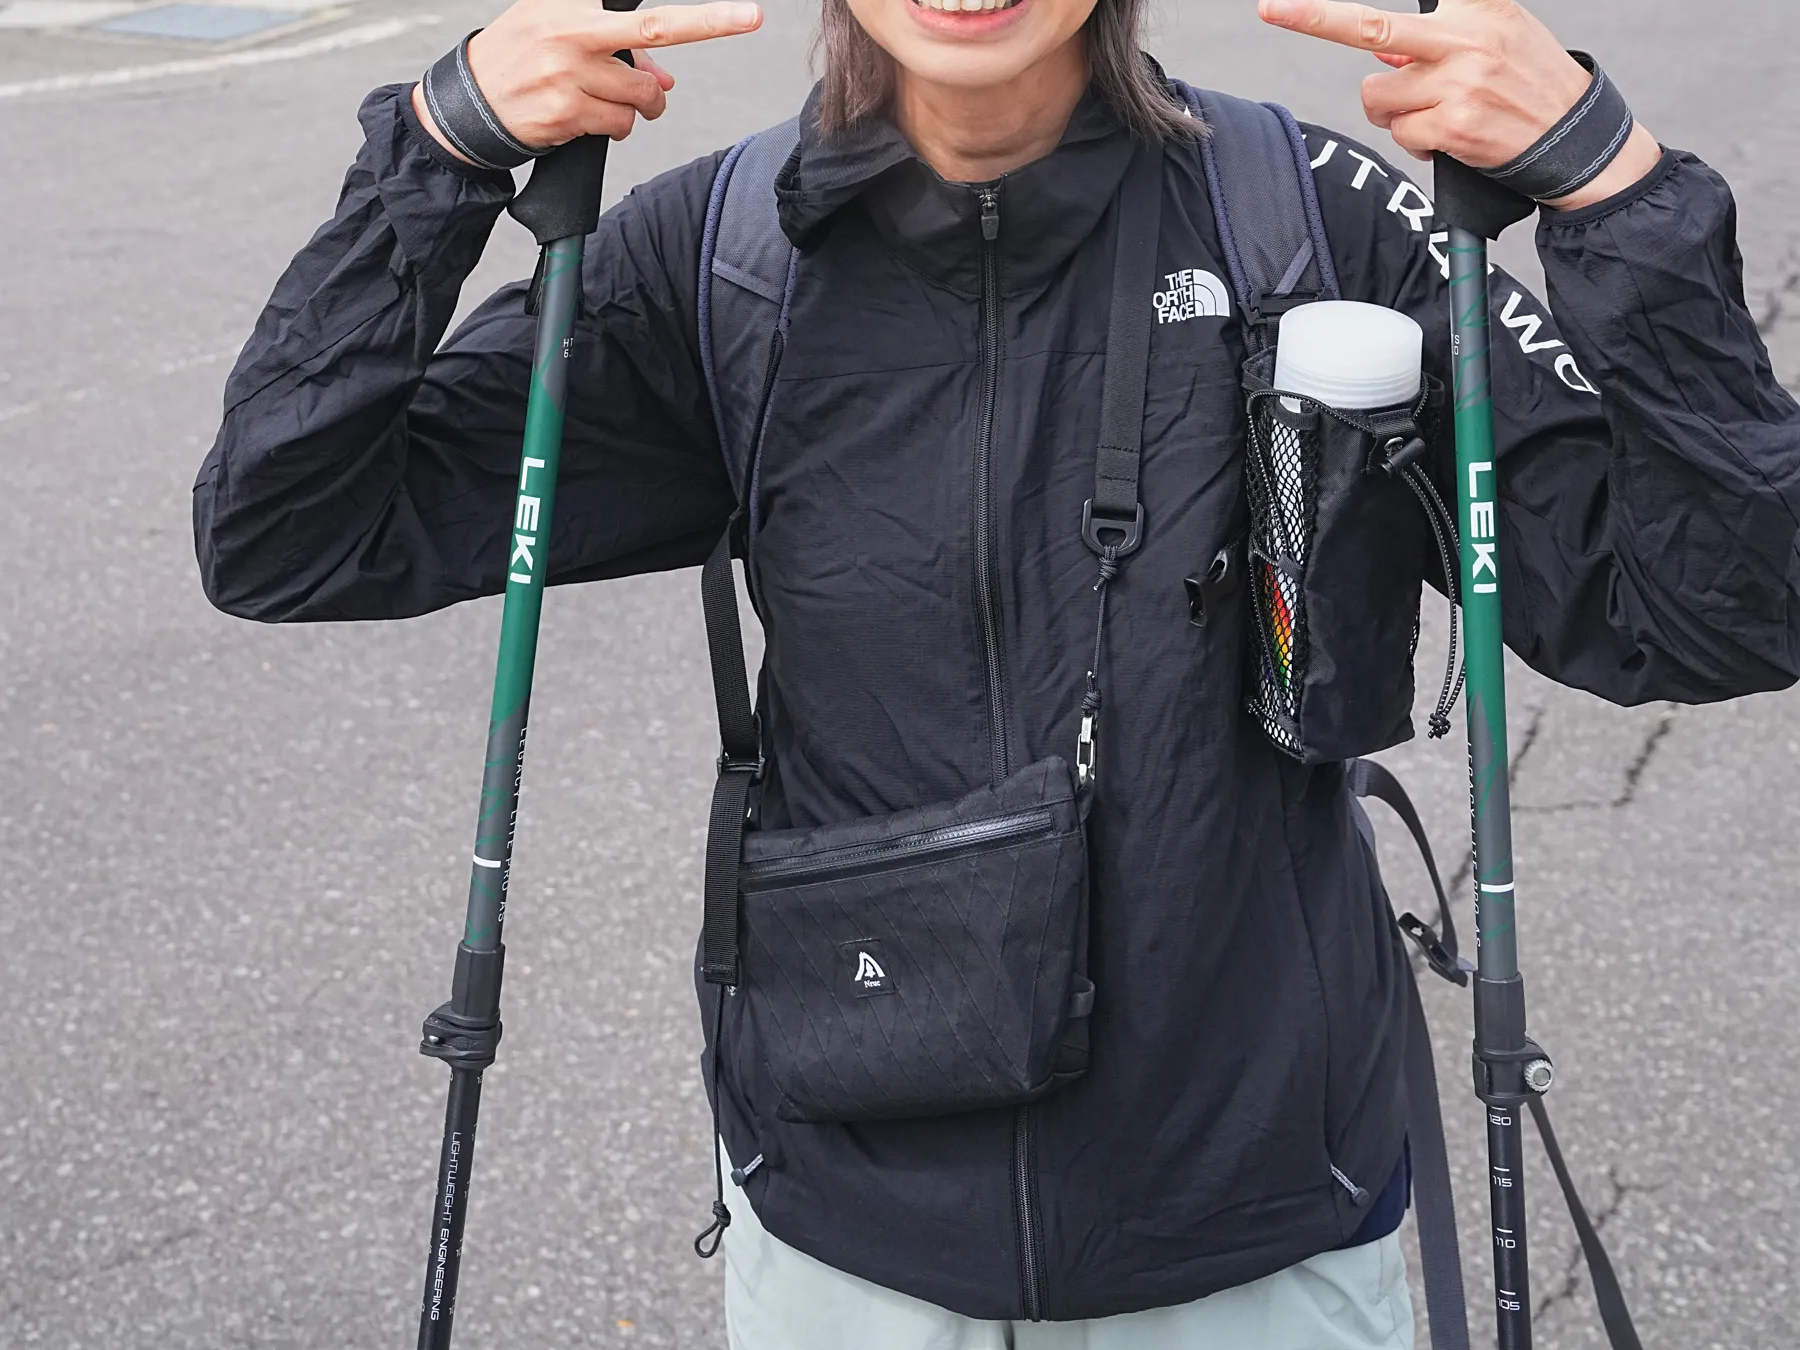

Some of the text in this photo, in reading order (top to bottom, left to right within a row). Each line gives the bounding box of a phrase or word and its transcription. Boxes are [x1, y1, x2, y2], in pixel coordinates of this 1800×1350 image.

[1164, 269, 1193, 290] THE
[1152, 284, 1194, 309] ORTH
[1158, 301, 1195, 324] FACE
[509, 456, 546, 585] LEKI
[1468, 461, 1497, 594] LEKI
[1489, 1113, 1512, 1126] 120
[1493, 1175, 1513, 1188] 115
[430, 1131, 462, 1320] LIGHTWEIGHT ENGINEERING
[1495, 1236, 1516, 1249] 110
[1498, 1297, 1520, 1311] 105
